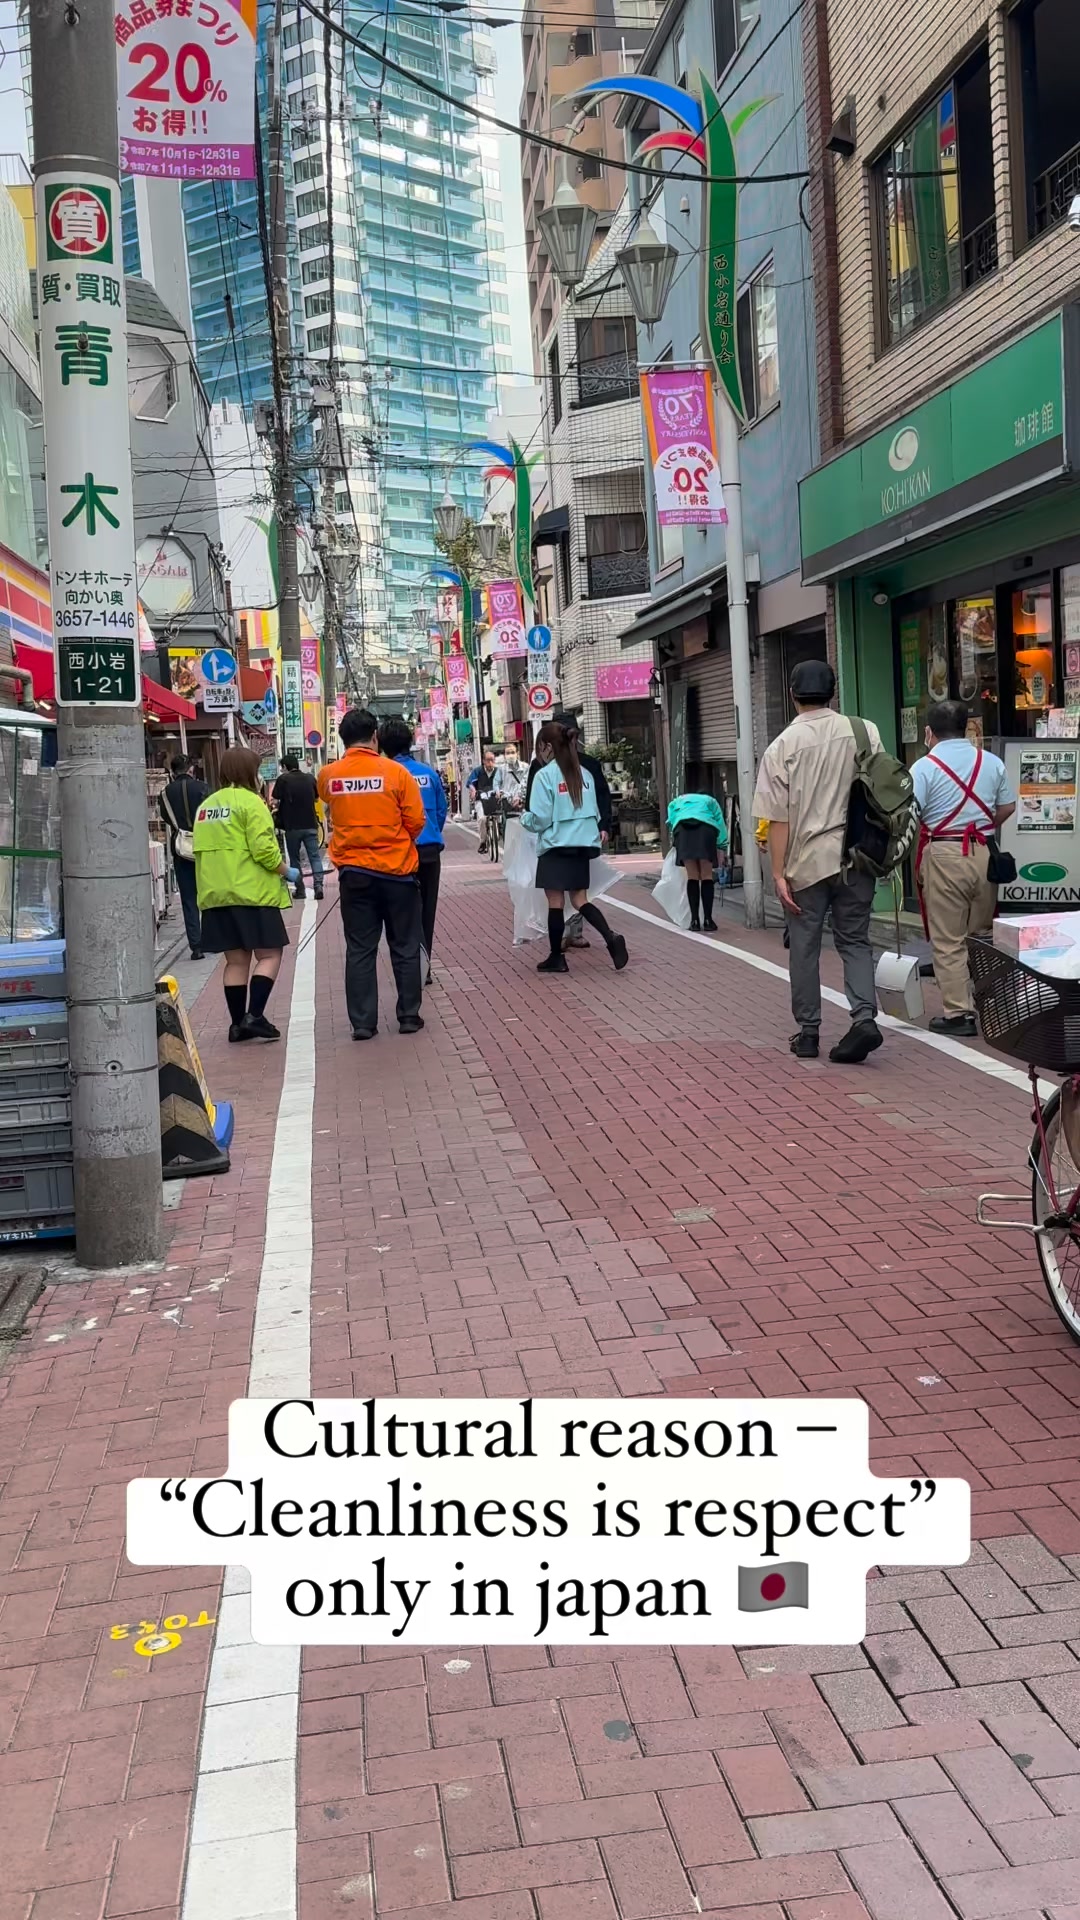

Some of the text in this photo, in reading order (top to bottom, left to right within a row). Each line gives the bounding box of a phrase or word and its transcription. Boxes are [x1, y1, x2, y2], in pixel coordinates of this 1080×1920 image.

[114, 0, 240, 48] 商品券まつり
[126, 42, 228, 104] 20%
[132, 106, 208, 136] お得!!
[56, 200, 105, 247] 質
[42, 272, 121, 308] 質・買取
[713, 254, 735, 364] 西小岩通り会
[1013, 403, 1054, 447] 珈琲館
[55, 570, 133, 587] ドンキホーテ
[65, 589, 124, 606] 向かい奥
[55, 609, 135, 628] 3657-1446
[68, 651, 126, 670] 西小岩
[73, 676, 123, 694] 1-21
[344, 778, 382, 791] マルハン
